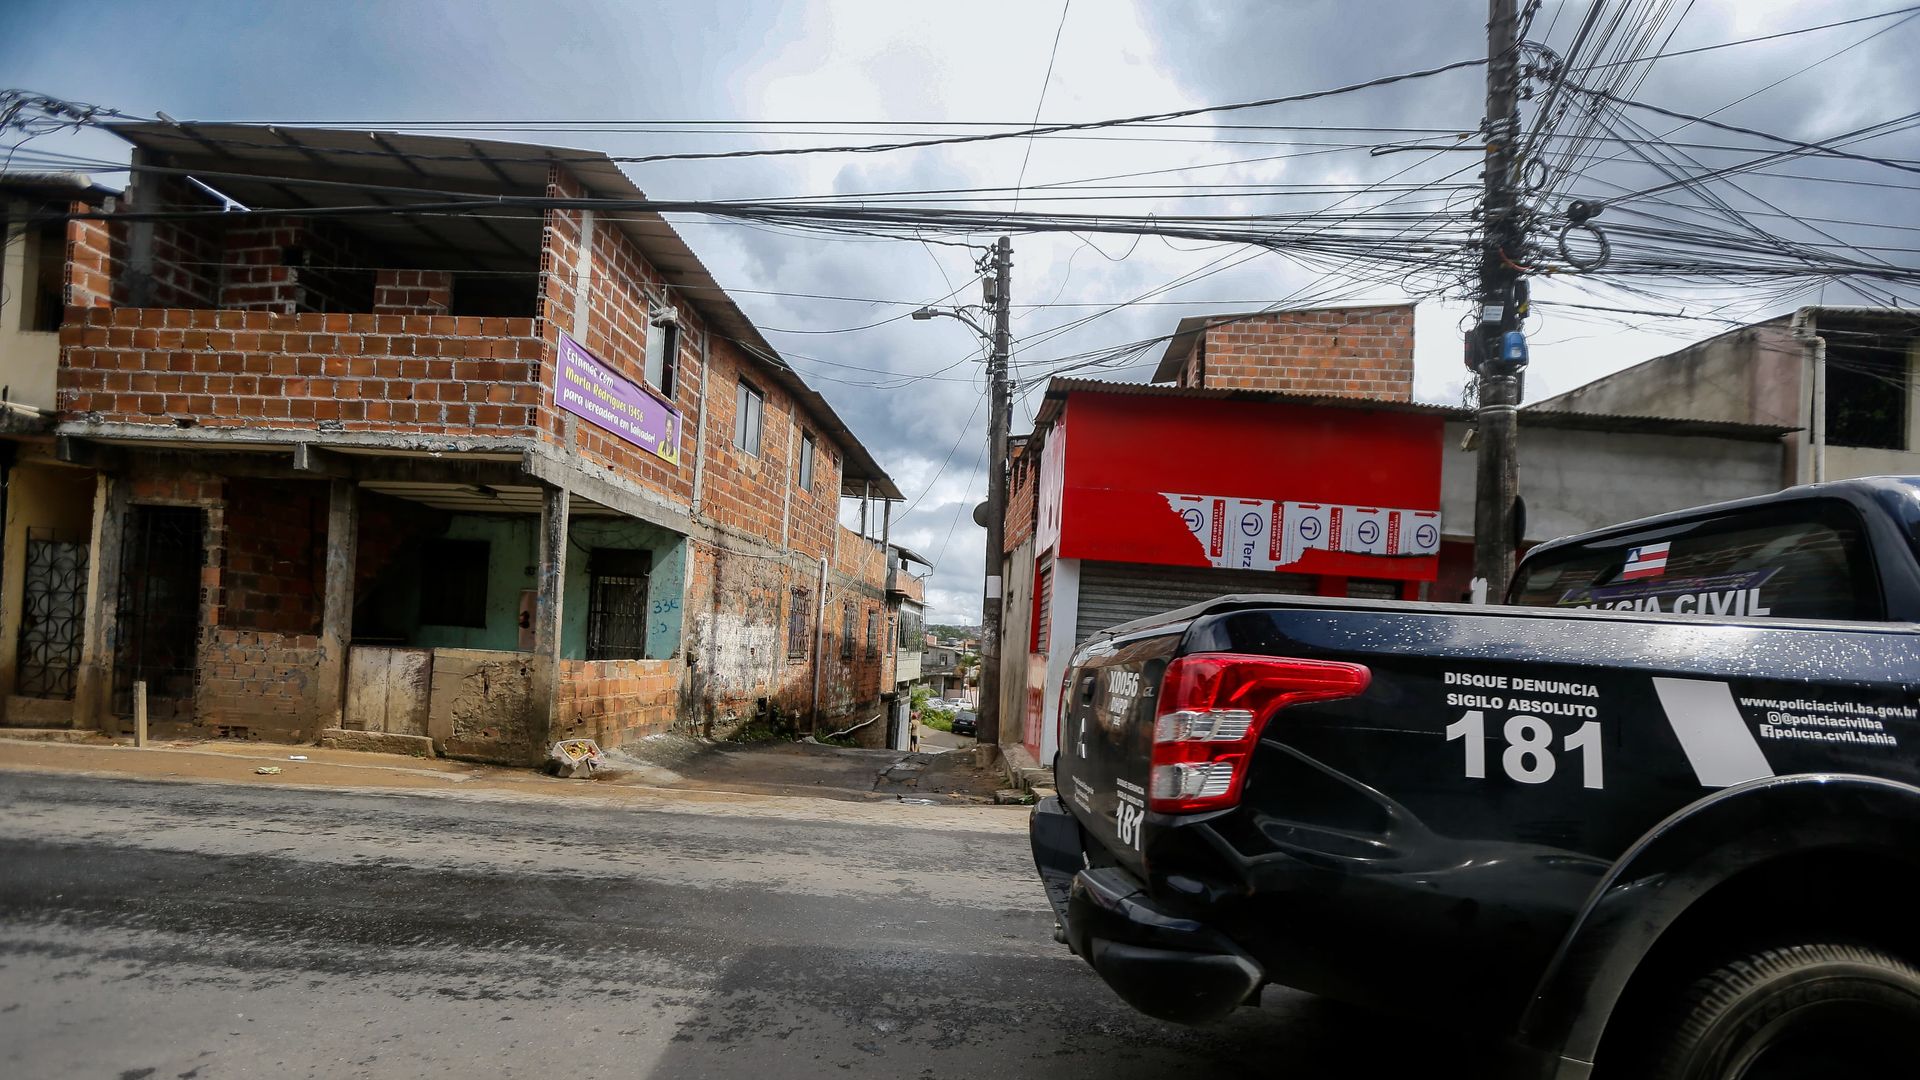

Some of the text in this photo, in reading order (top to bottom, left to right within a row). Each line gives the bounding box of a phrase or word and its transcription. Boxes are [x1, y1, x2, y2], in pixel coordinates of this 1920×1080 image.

[567, 347, 615, 389] Estamos com
[563, 387, 584, 407] para
[584, 398, 619, 426] vereadora
[619, 418, 630, 432] em
[565, 365, 645, 423] Marta Rodrigues 13456
[1673, 588, 1771, 616] CIVIL
[1444, 672, 1600, 698] DISQUE DENUNCIA
[1446, 693, 1598, 719] SIGILO ABSOLUTO
[1740, 697, 1918, 718] www.policiacivil.ba.gov.br
[1781, 712, 1884, 730] @policiacivilba
[1445, 710, 1604, 790] 181
[1116, 800, 1145, 851] 181
